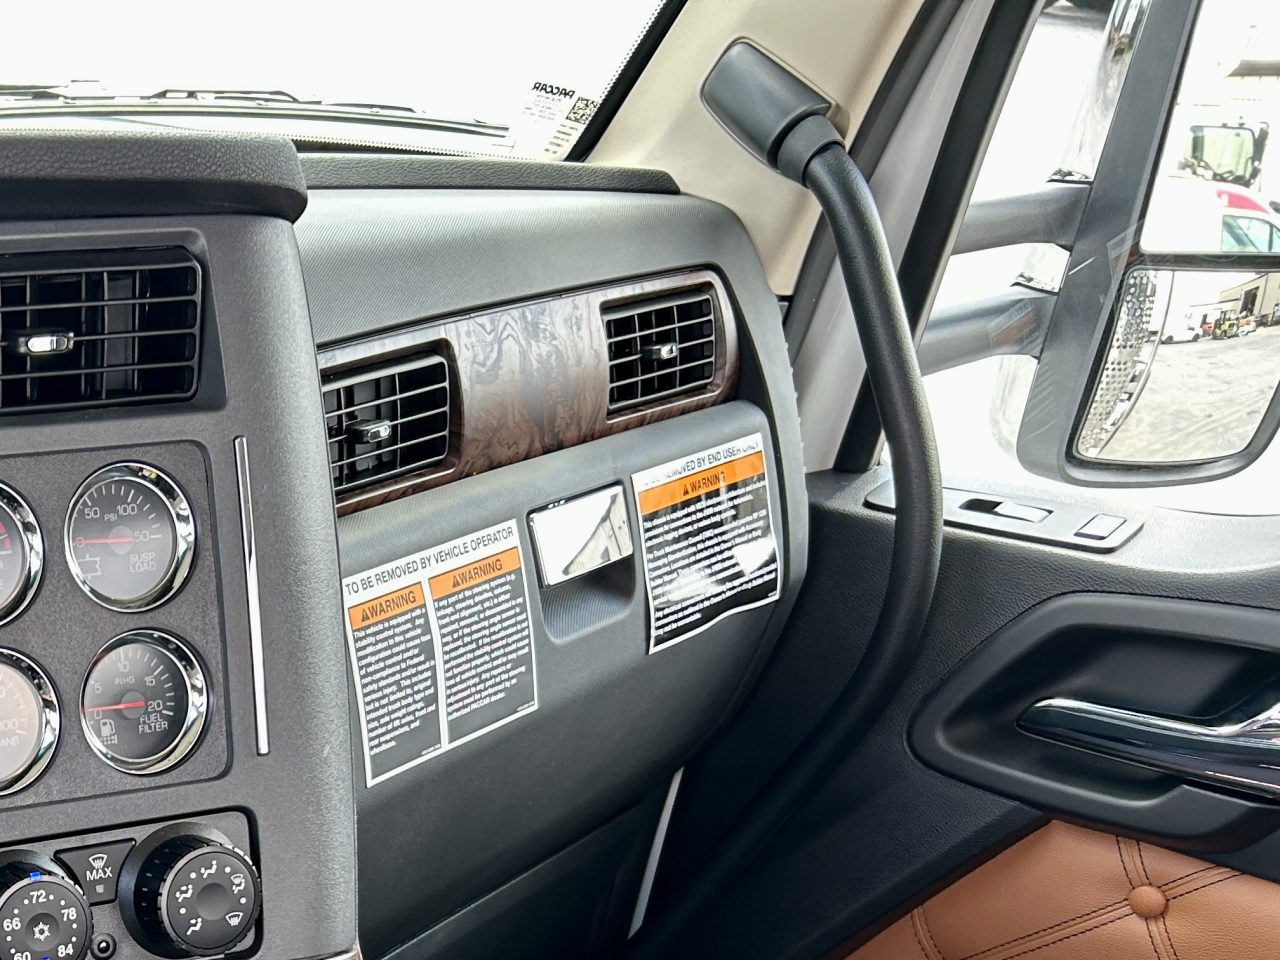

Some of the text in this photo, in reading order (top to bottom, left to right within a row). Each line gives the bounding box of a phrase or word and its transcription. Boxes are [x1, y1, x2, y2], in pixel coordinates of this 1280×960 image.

[697, 456, 706, 468] BY
[707, 451, 722, 465] END
[689, 470, 726, 493] WARNING
[85, 504, 137, 521] 50 PSI 100
[130, 552, 156, 563] SUSP
[345, 526, 514, 595] TO BE REMOVED BY VEHICLE OPERATOR
[130, 562, 156, 573] LOAD
[458, 558, 503, 585] WARNING
[367, 590, 417, 619] WARNING
[117, 661, 129, 672] 10
[94, 682, 102, 693] 5
[144, 675, 155, 686] 15
[147, 700, 163, 711] 20
[94, 711, 102, 719] 0
[140, 713, 163, 724] FUEL
[139, 721, 168, 734] FILTER
[86, 866, 113, 882] MAX
[29, 889, 47, 904] 72
[61, 907, 77, 922] 78
[3, 917, 21, 932] 66
[57, 943, 74, 958] 84
